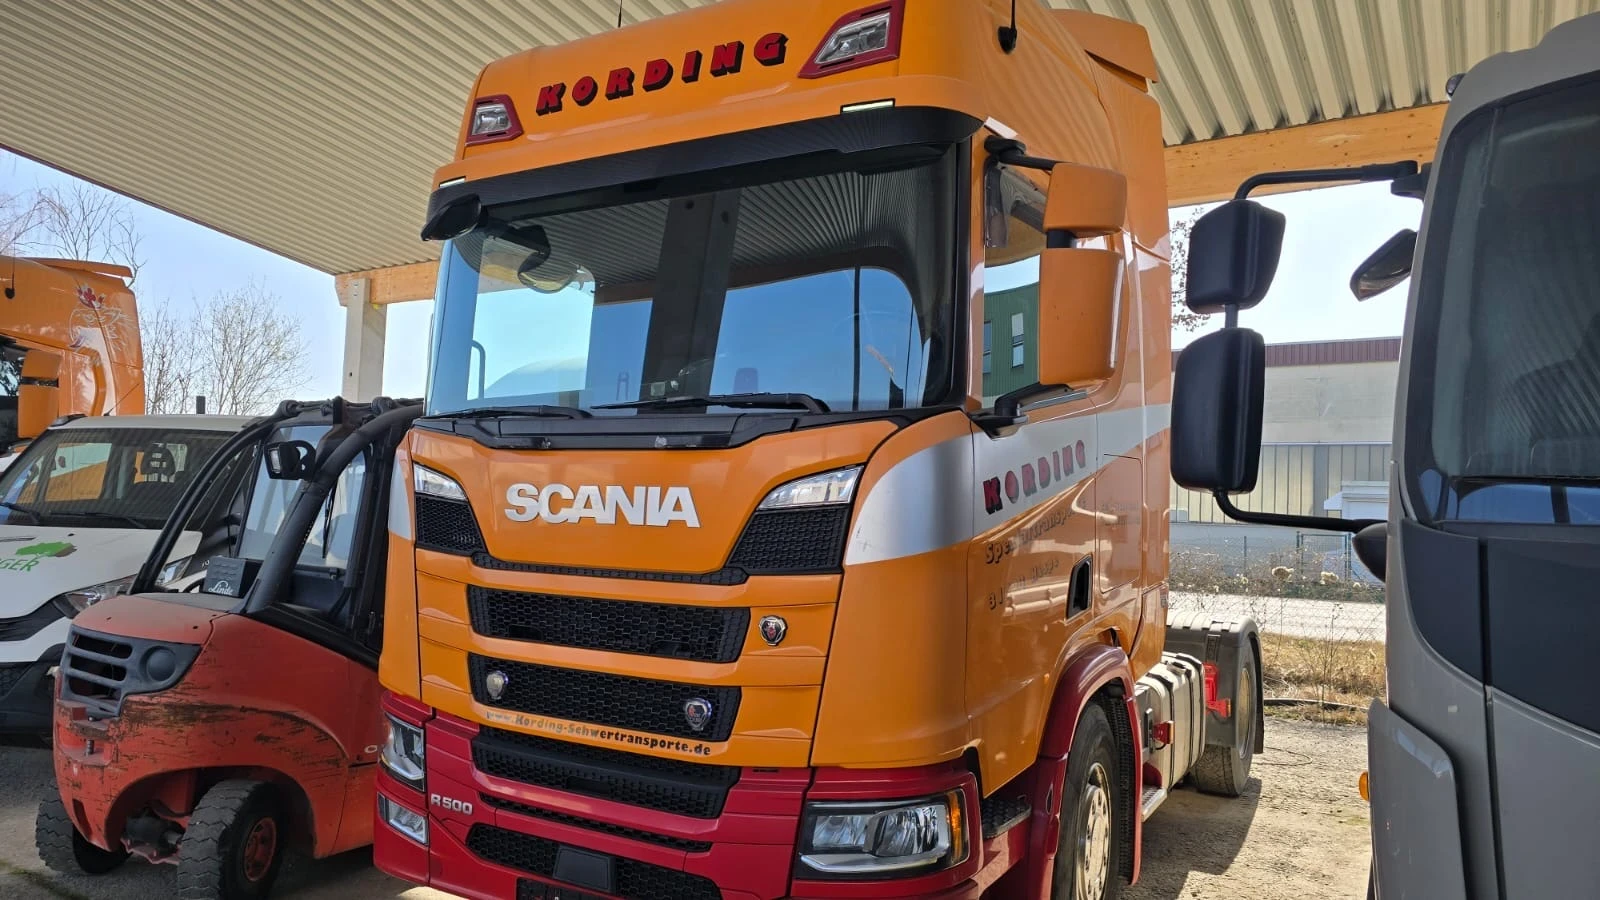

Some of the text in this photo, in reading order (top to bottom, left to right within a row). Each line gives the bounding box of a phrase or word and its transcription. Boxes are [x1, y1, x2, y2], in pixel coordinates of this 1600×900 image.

[536, 32, 788, 116] KORDING
[983, 440, 1086, 515] KORDING
[504, 483, 700, 528] SCANIA
[208, 580, 234, 596] Linde
[431, 793, 473, 815] R 500
